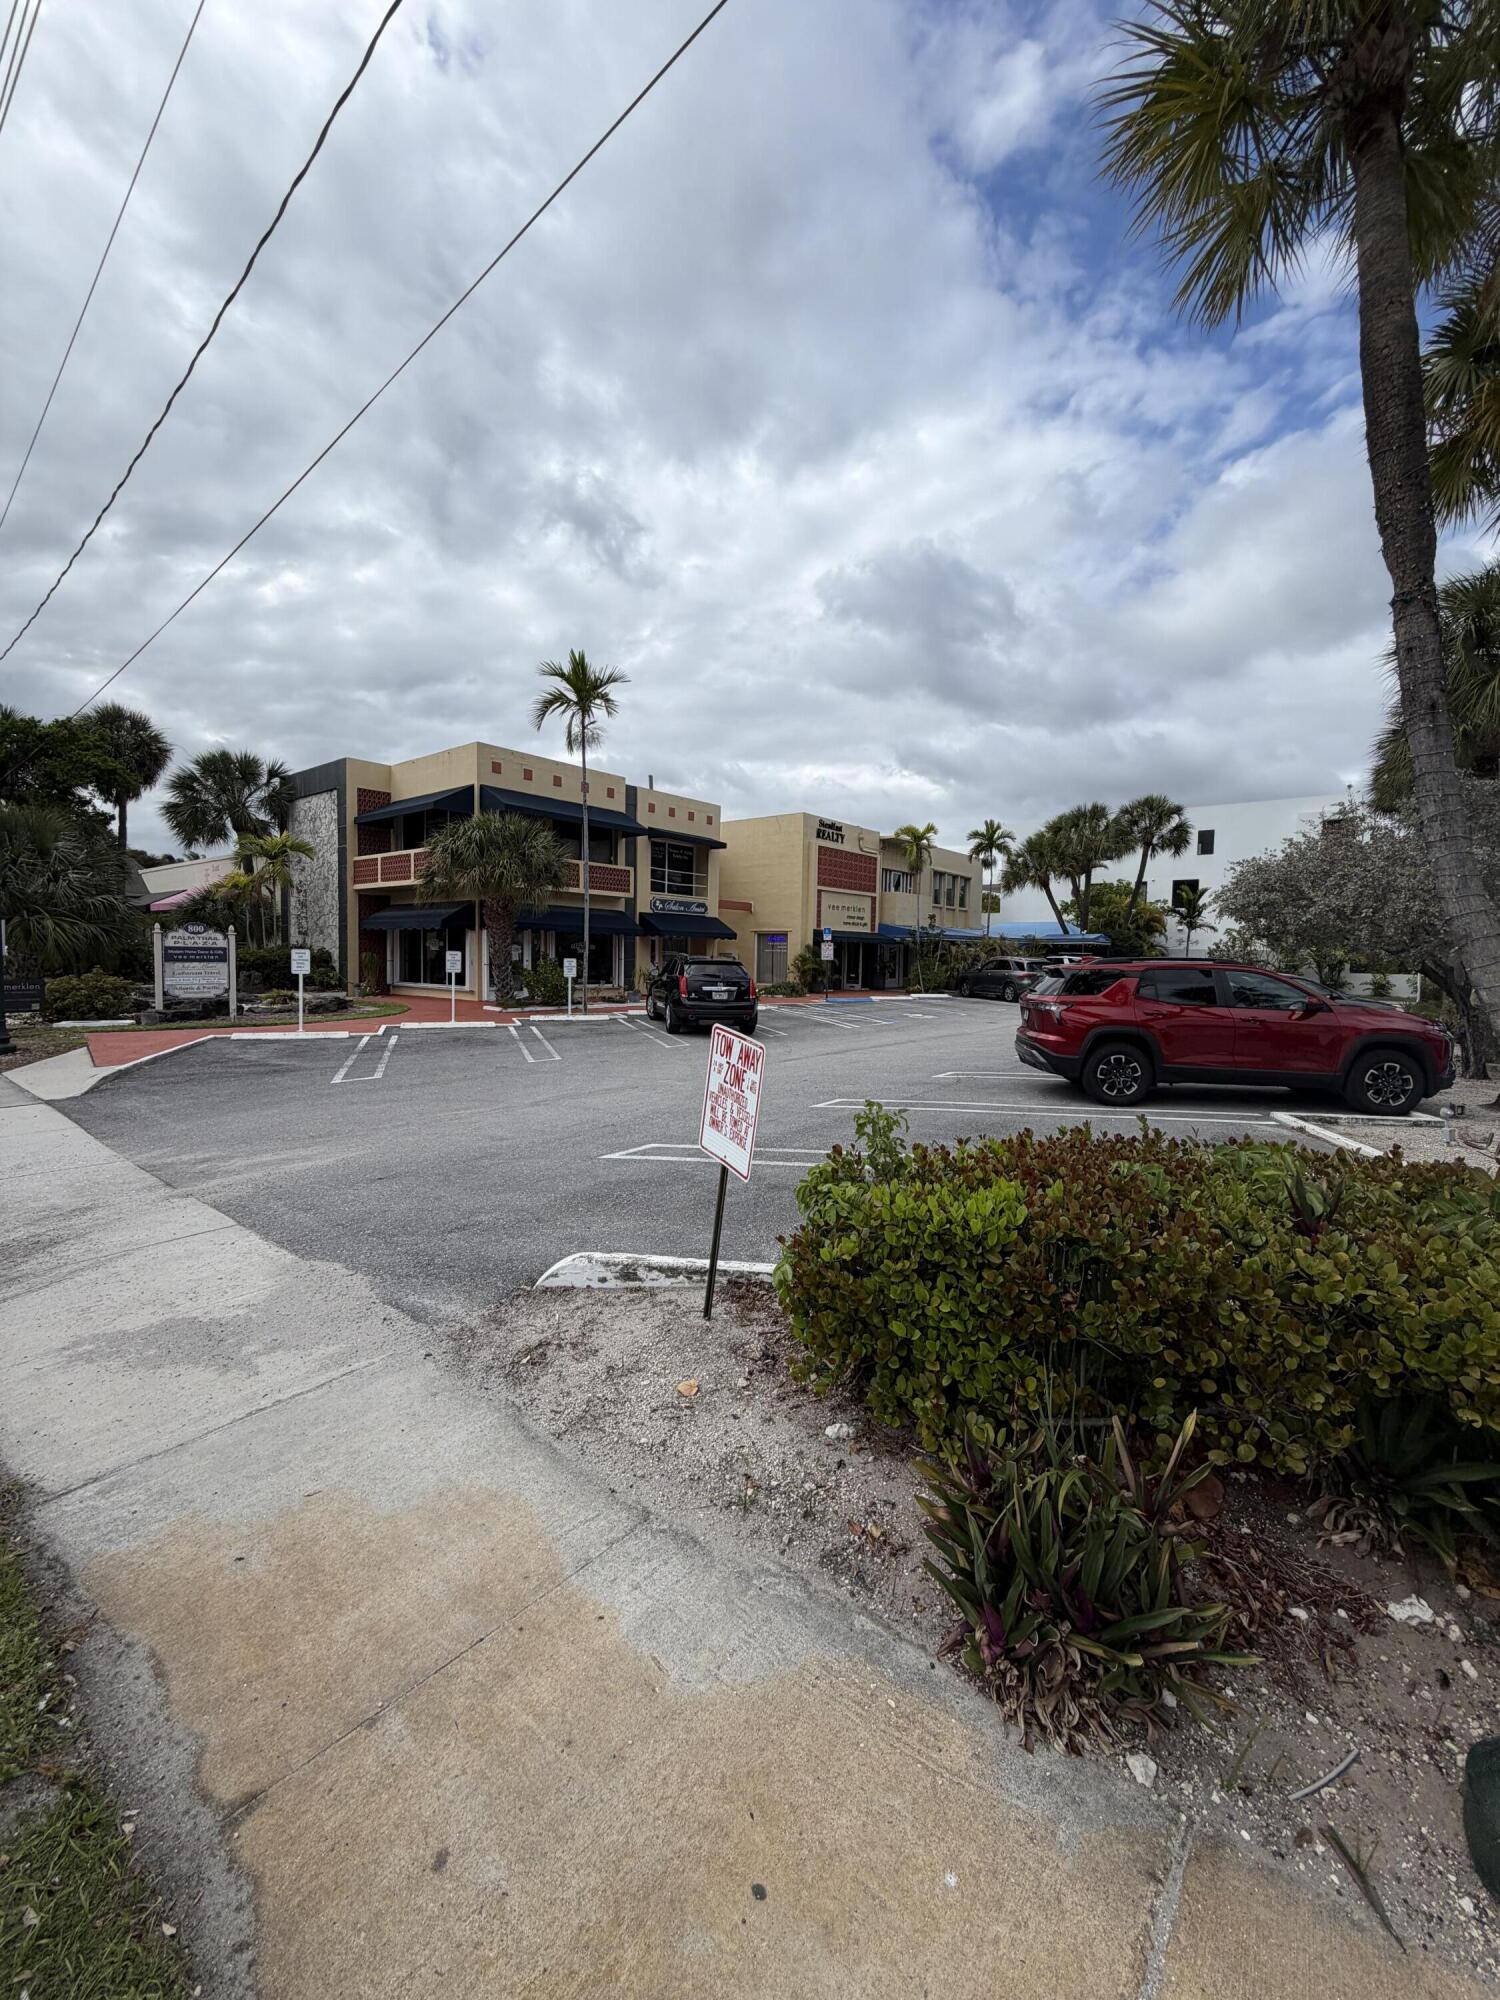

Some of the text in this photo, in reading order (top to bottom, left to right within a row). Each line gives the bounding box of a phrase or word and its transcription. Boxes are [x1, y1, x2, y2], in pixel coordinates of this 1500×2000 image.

[816, 829, 845, 844] REALTY
[188, 925, 204, 933] 800
[715, 1031, 762, 1075] TOW AWAY
[722, 1061, 748, 1094] ZONE
